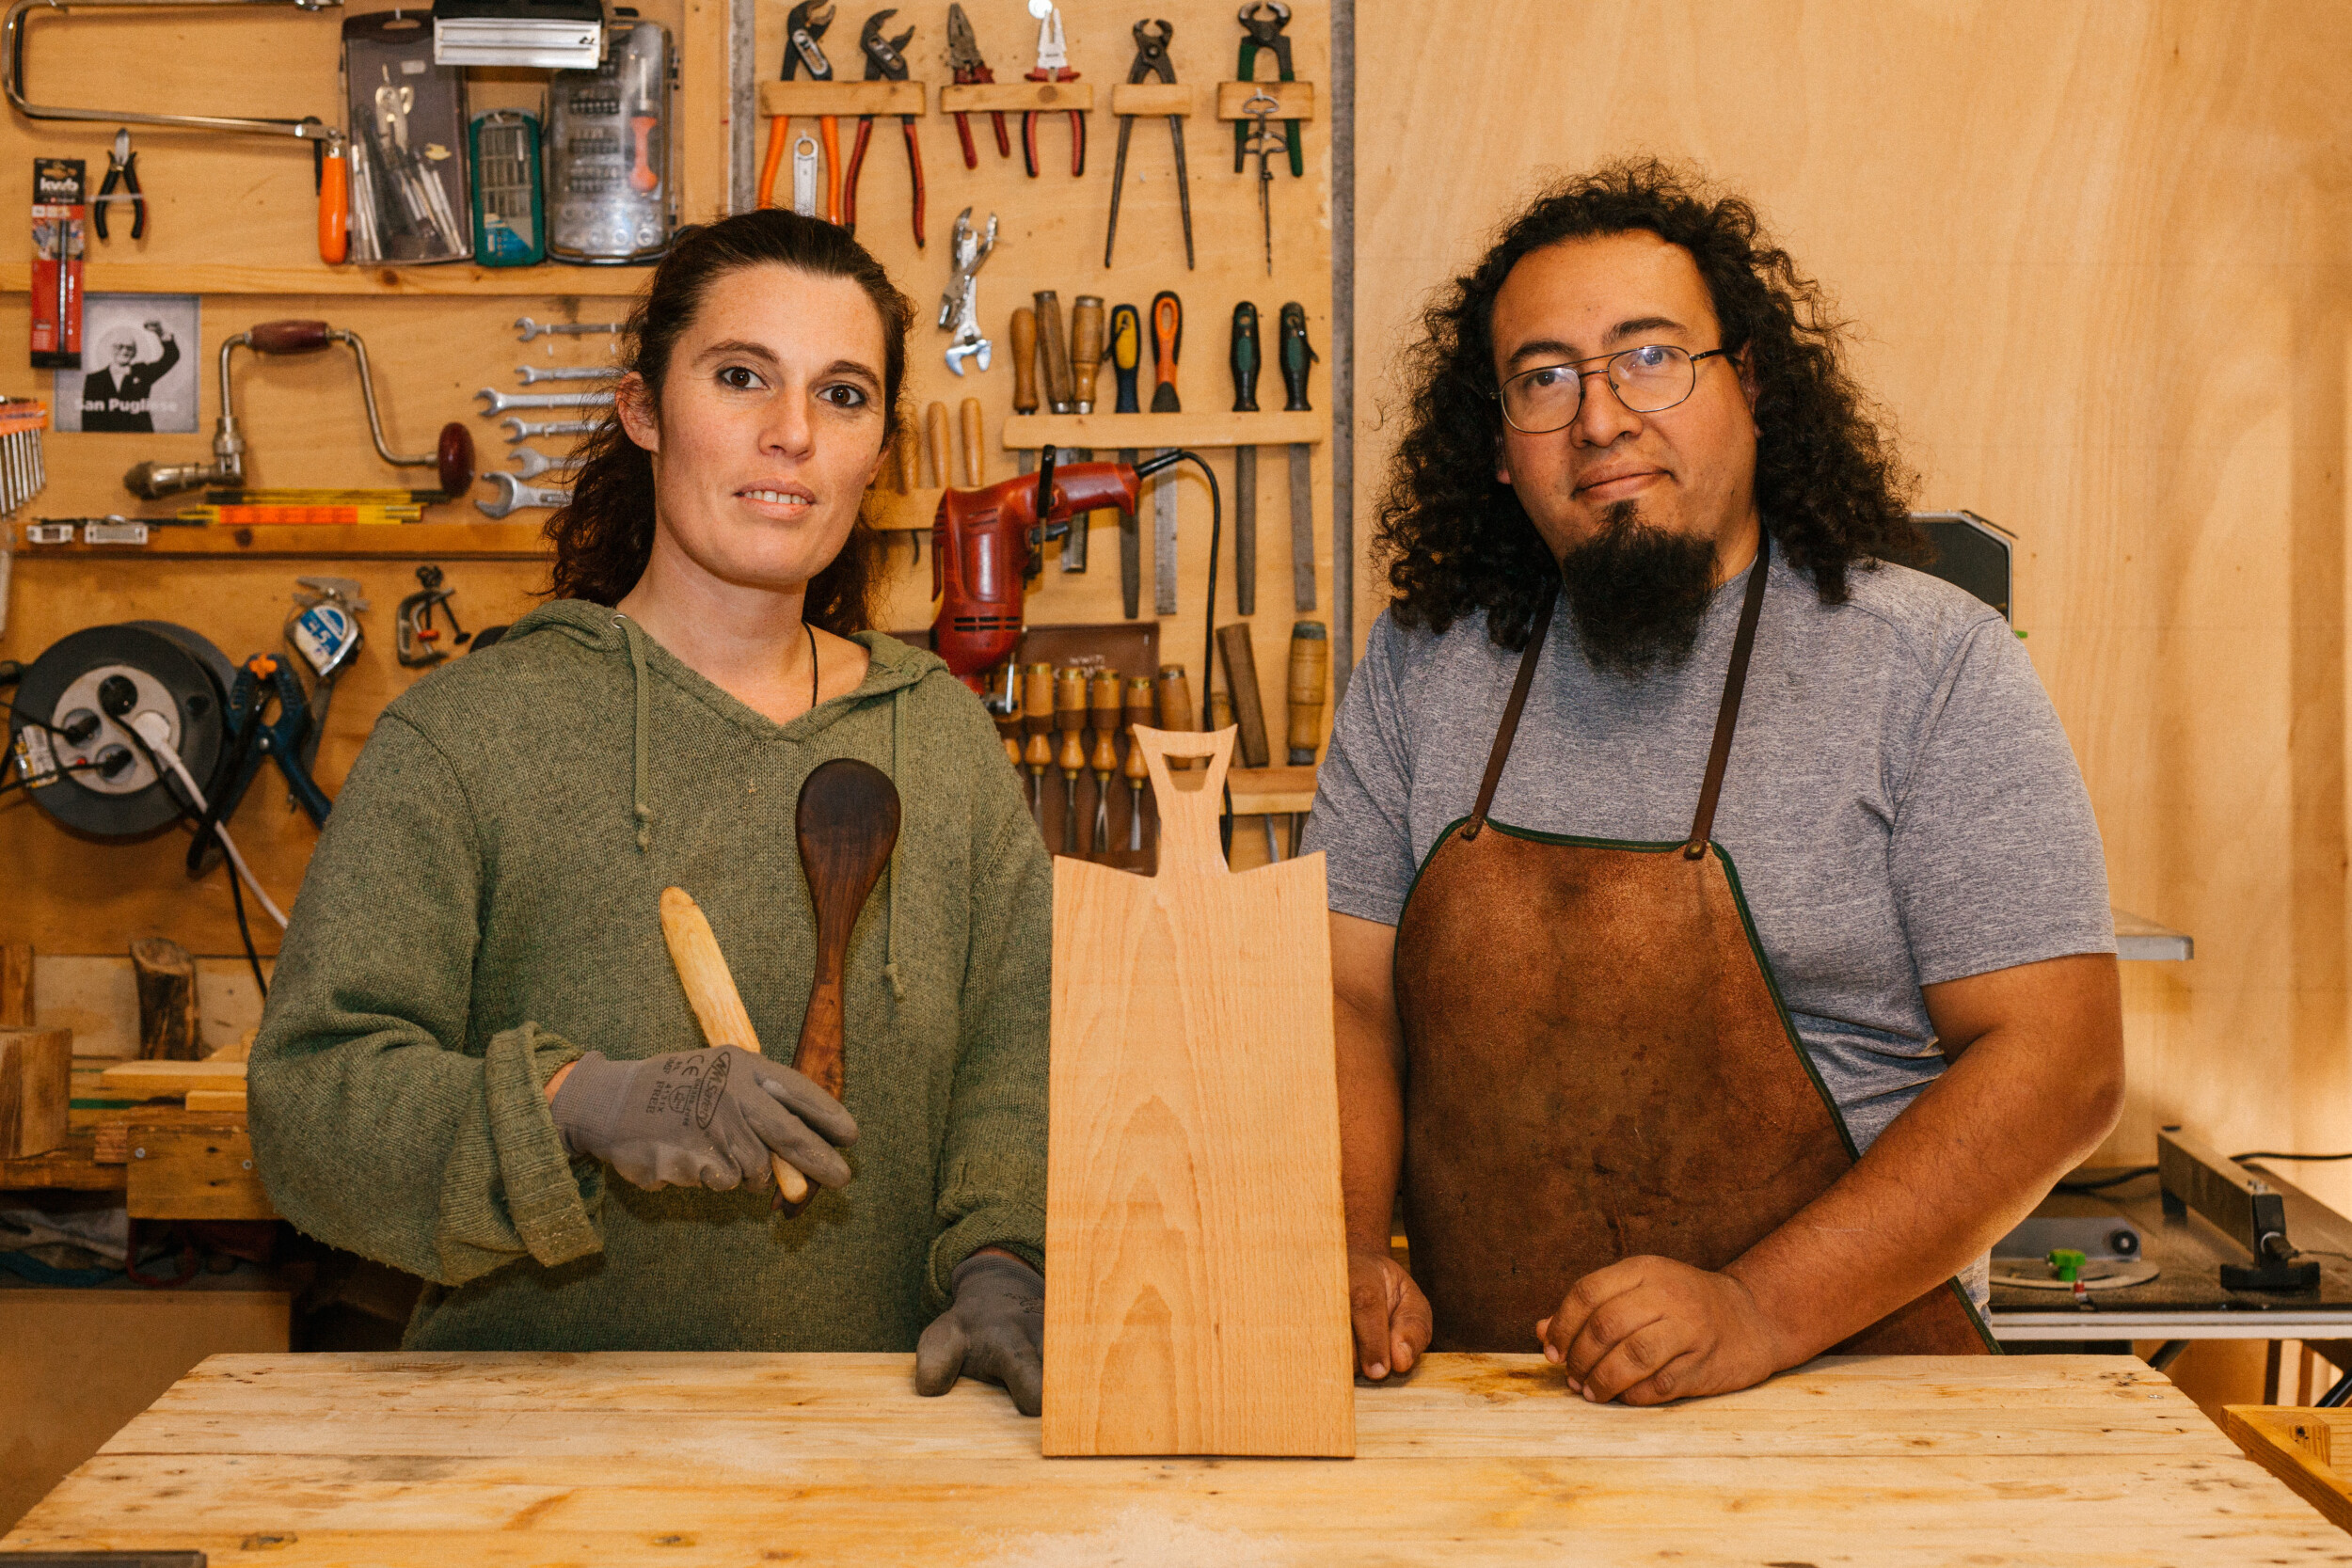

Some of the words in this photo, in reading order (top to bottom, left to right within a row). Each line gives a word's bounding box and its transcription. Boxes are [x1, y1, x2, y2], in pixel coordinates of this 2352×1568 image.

[40, 177, 79, 192] kwb
[75, 398, 105, 412] San
[681, 1054, 705, 1076] CE
[645, 1081, 665, 1115] FREE
